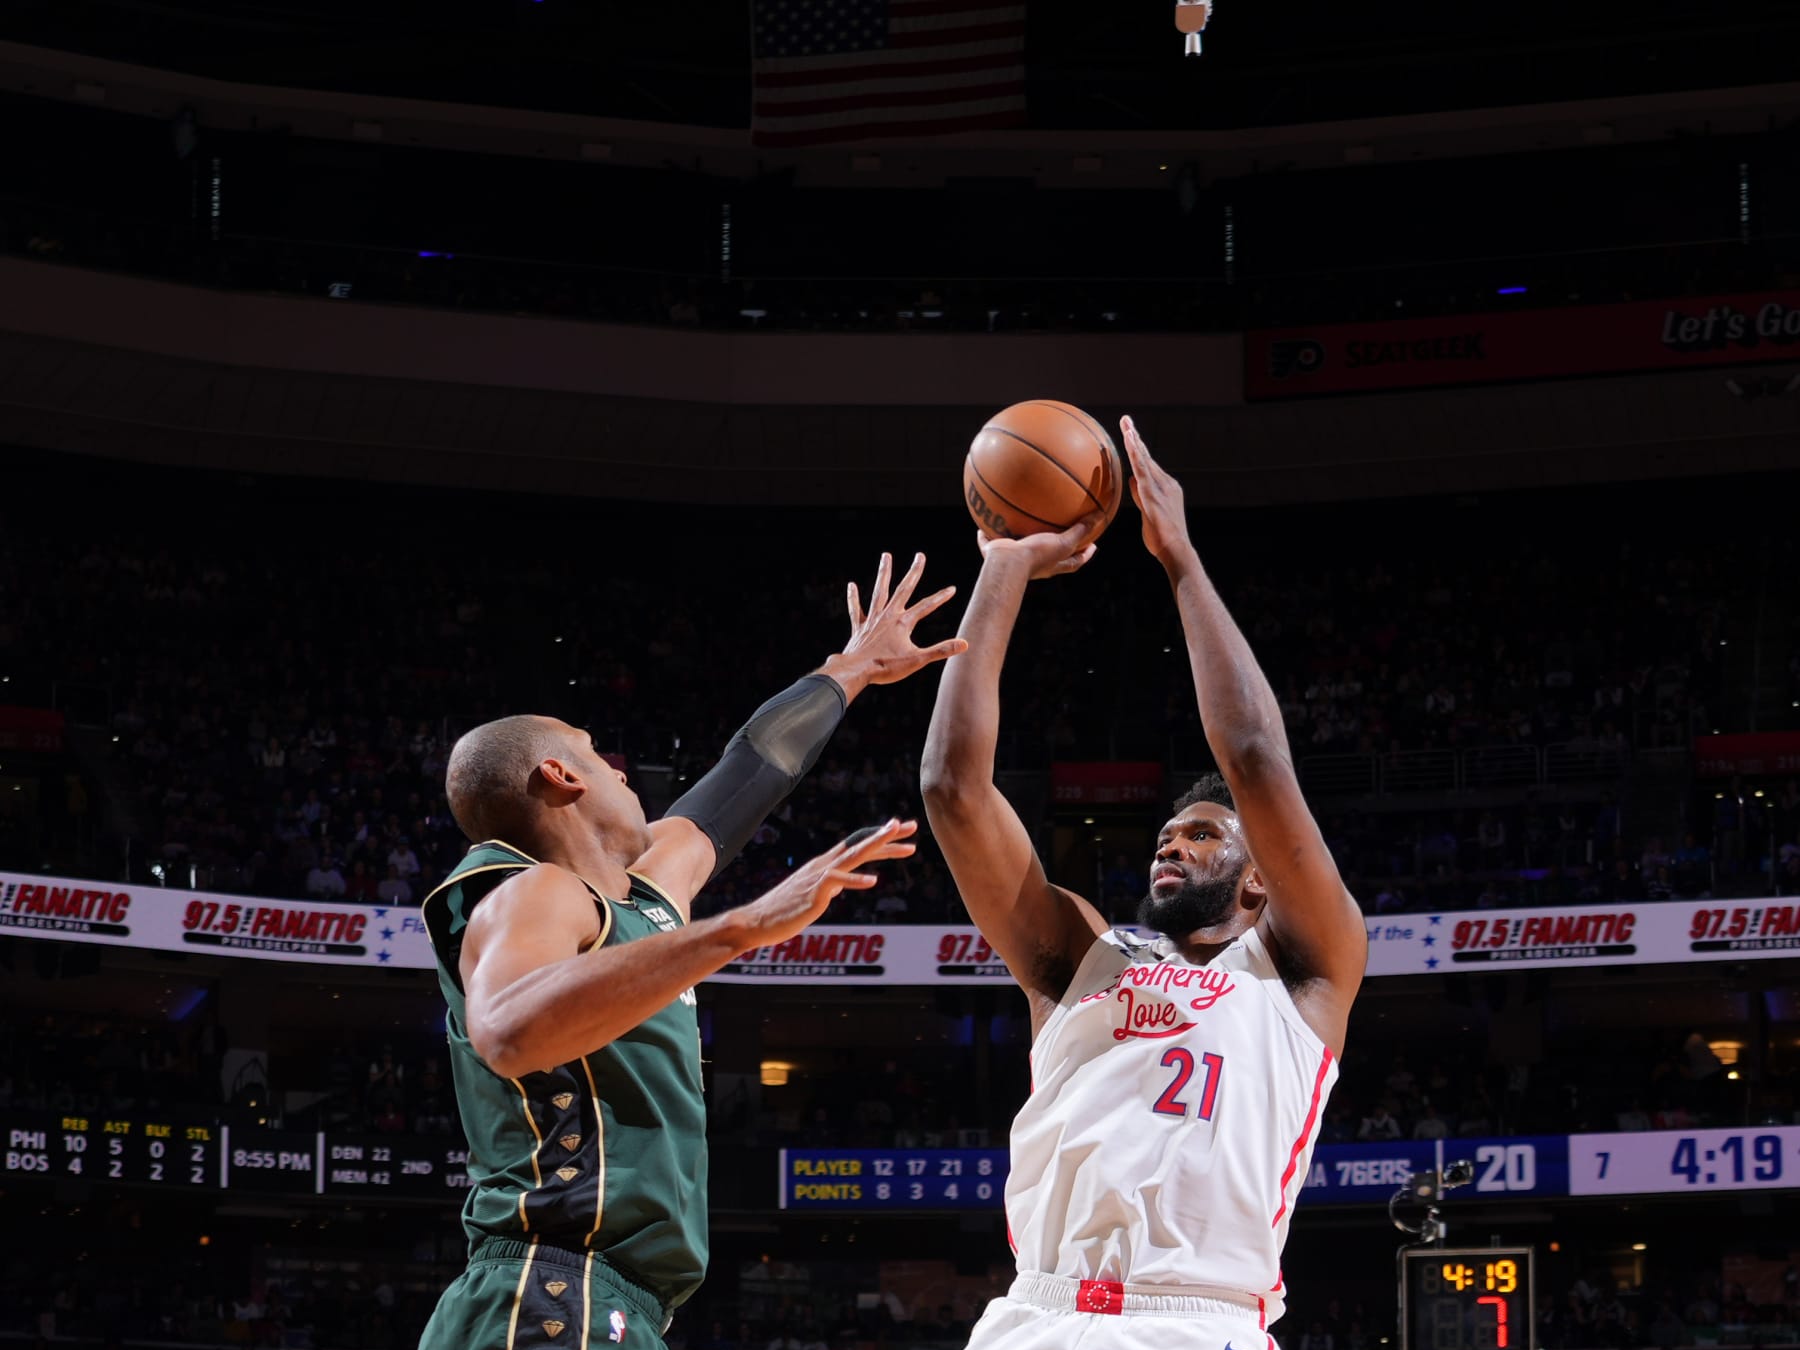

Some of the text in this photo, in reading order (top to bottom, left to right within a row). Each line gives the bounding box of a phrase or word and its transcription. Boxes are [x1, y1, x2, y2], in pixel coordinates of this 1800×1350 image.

[1660, 305, 1745, 344] Let's
[13, 883, 130, 923] FANATIC
[0, 914, 91, 932] ILADELPHIA
[182, 900, 241, 934] 97.5
[251, 907, 367, 943] FANATIC
[1385, 925, 1414, 940] the
[1451, 918, 1510, 950] 97.5
[1519, 912, 1637, 947] FANATIC
[1690, 908, 1750, 939] 97.5
[221, 937, 328, 954] PHILADELPHIA
[771, 935, 885, 964] FANATIC
[937, 934, 992, 963] 97.5
[1490, 946, 1598, 961] PHILADELPHIA
[1729, 938, 1800, 950] PHILADEL
[740, 965, 847, 976] PHILADELPHIA
[1082, 960, 1236, 1010] rotherly
[1113, 987, 1198, 1040] Love
[1152, 1047, 1224, 1122] 21
[61, 1117, 211, 1141] REB AST BLK STL
[9, 1129, 204, 1162] PHI 10 5 0 2
[233, 1148, 312, 1172] 8:55 PM
[331, 1146, 391, 1162] DEN 22
[1670, 1135, 1783, 1184] 4:19
[5, 1151, 204, 1184] BOS 4 2 2 2
[331, 1169, 391, 1185] MEM 42
[400, 1160, 433, 1175] 2ND
[793, 1159, 993, 1176] PLAYER 12 17 21 8
[1335, 1158, 1411, 1187] 76ERS
[1475, 1143, 1536, 1192] 20
[1595, 1152, 1611, 1179] 7
[794, 1182, 992, 1200] POINTS 8 3 4 0
[1442, 1259, 1518, 1293] 4:19
[1476, 1295, 1508, 1348] 7
